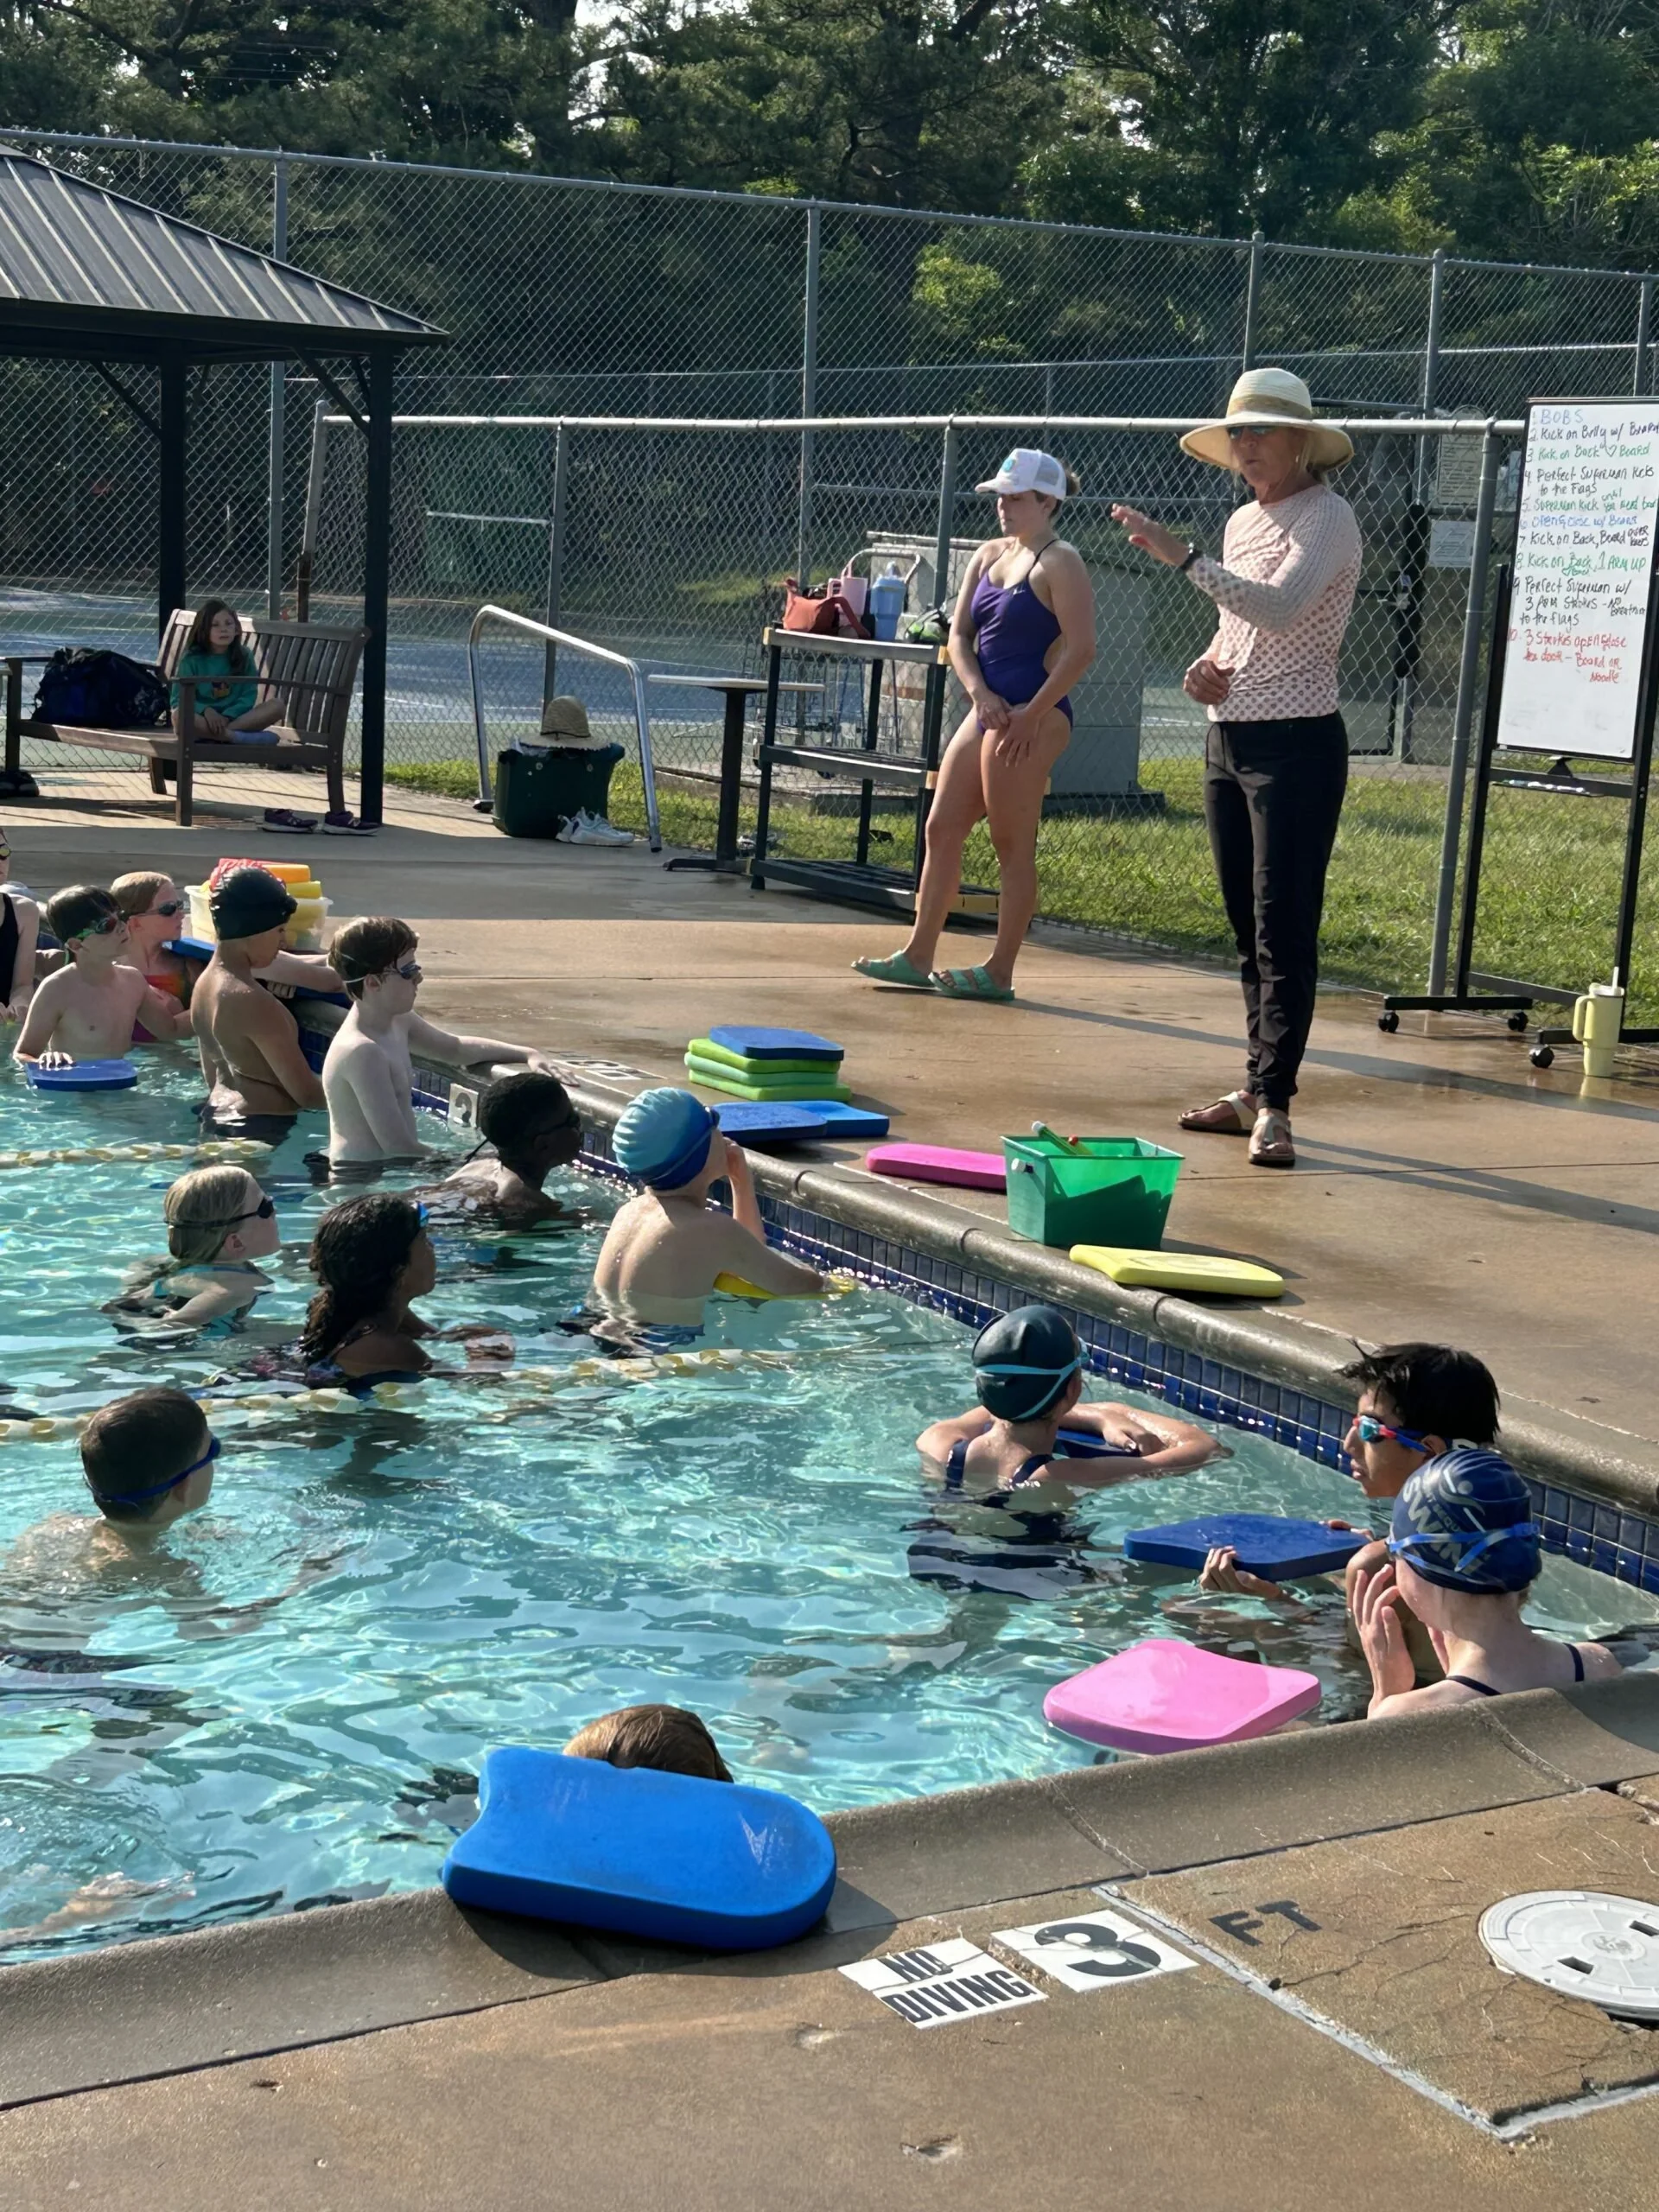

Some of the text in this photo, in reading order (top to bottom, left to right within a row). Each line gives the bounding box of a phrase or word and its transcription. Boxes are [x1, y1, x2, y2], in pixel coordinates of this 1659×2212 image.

[1541, 408, 1583, 424] BOBS
[1541, 429, 1563, 441] Kick
[1566, 429, 1578, 441] on
[1560, 449, 1570, 460] on
[1540, 484, 1548, 497] to
[1530, 531, 1554, 546] Kick
[1557, 533, 1569, 545] on
[1527, 550, 1549, 569] Kick
[1551, 556, 1565, 569] on
[1615, 580, 1632, 595] w/
[1525, 596, 1534, 612] 3
[1520, 612, 1530, 626] to
[1524, 628, 1534, 645] 3
[1402, 1475, 1490, 1575] SWIM
[879, 1900, 1322, 1982] NO 3 FT
[880, 1968, 1037, 2024] DIVING
